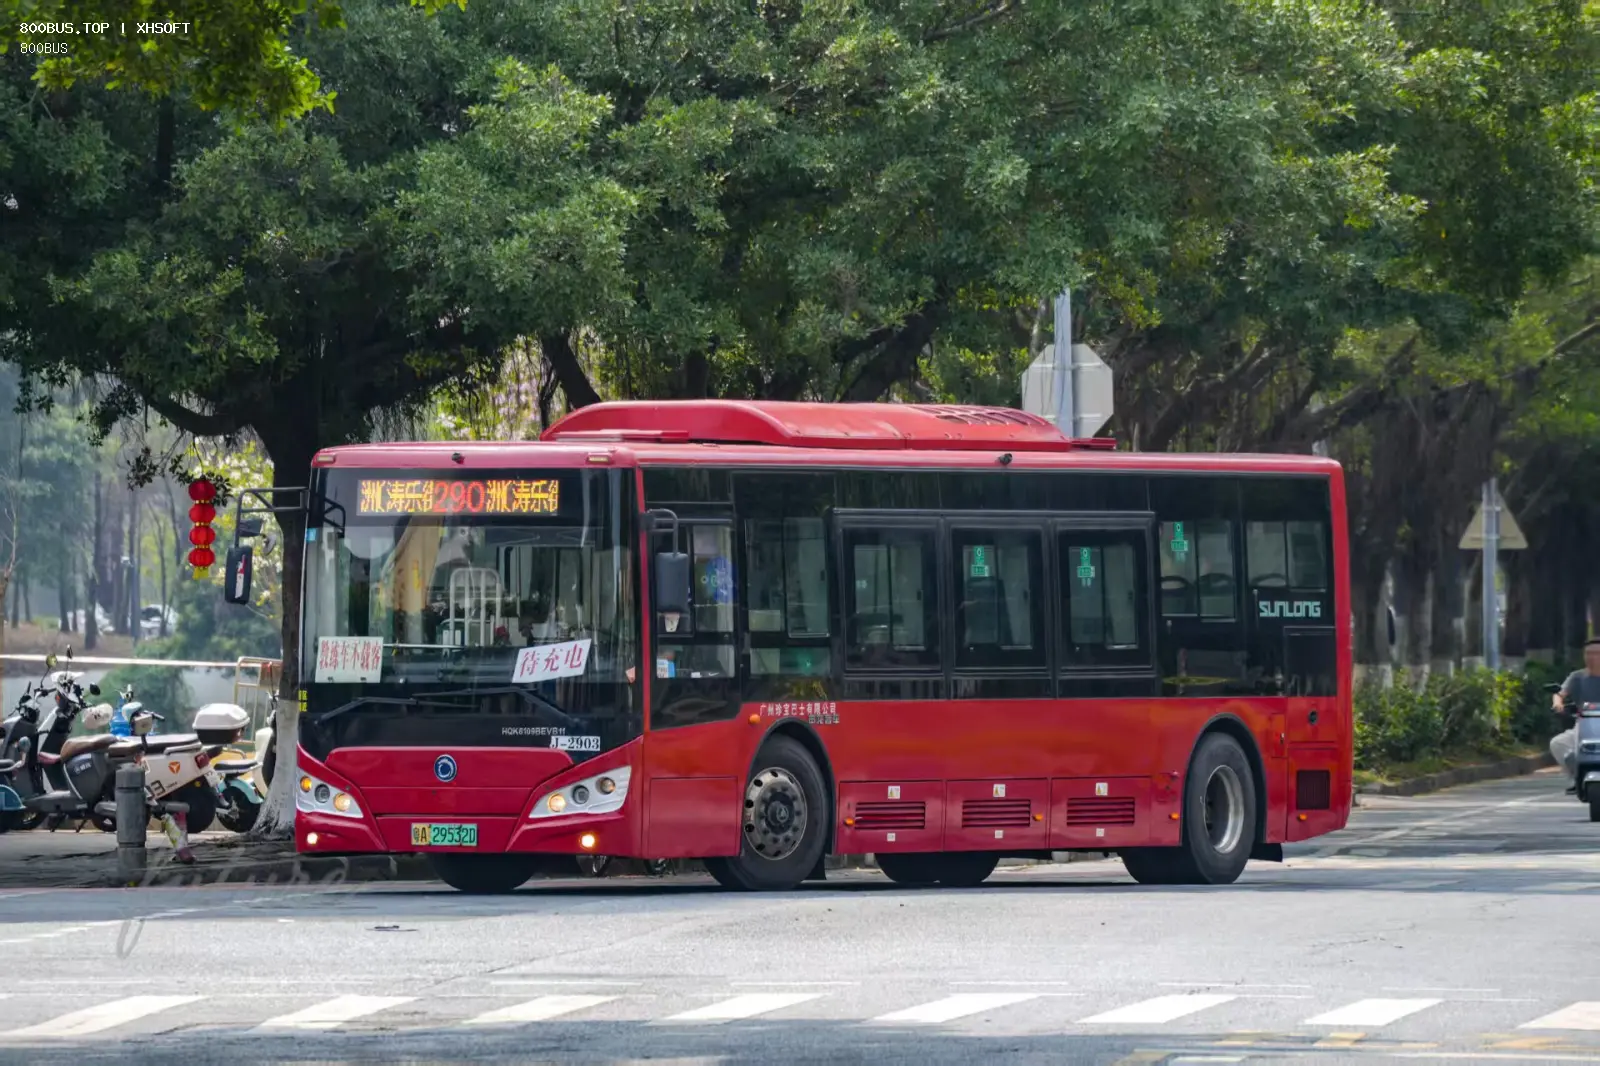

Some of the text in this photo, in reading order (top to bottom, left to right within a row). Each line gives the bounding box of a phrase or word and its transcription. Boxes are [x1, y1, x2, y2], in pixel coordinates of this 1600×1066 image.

[433, 481, 485, 513] 290
[1259, 600, 1321, 617] SUNLONG
[519, 643, 583, 677] 待充电
[759, 702, 837, 716] 广州珍宝巴士有限公司
[550, 737, 600, 750] J-2903
